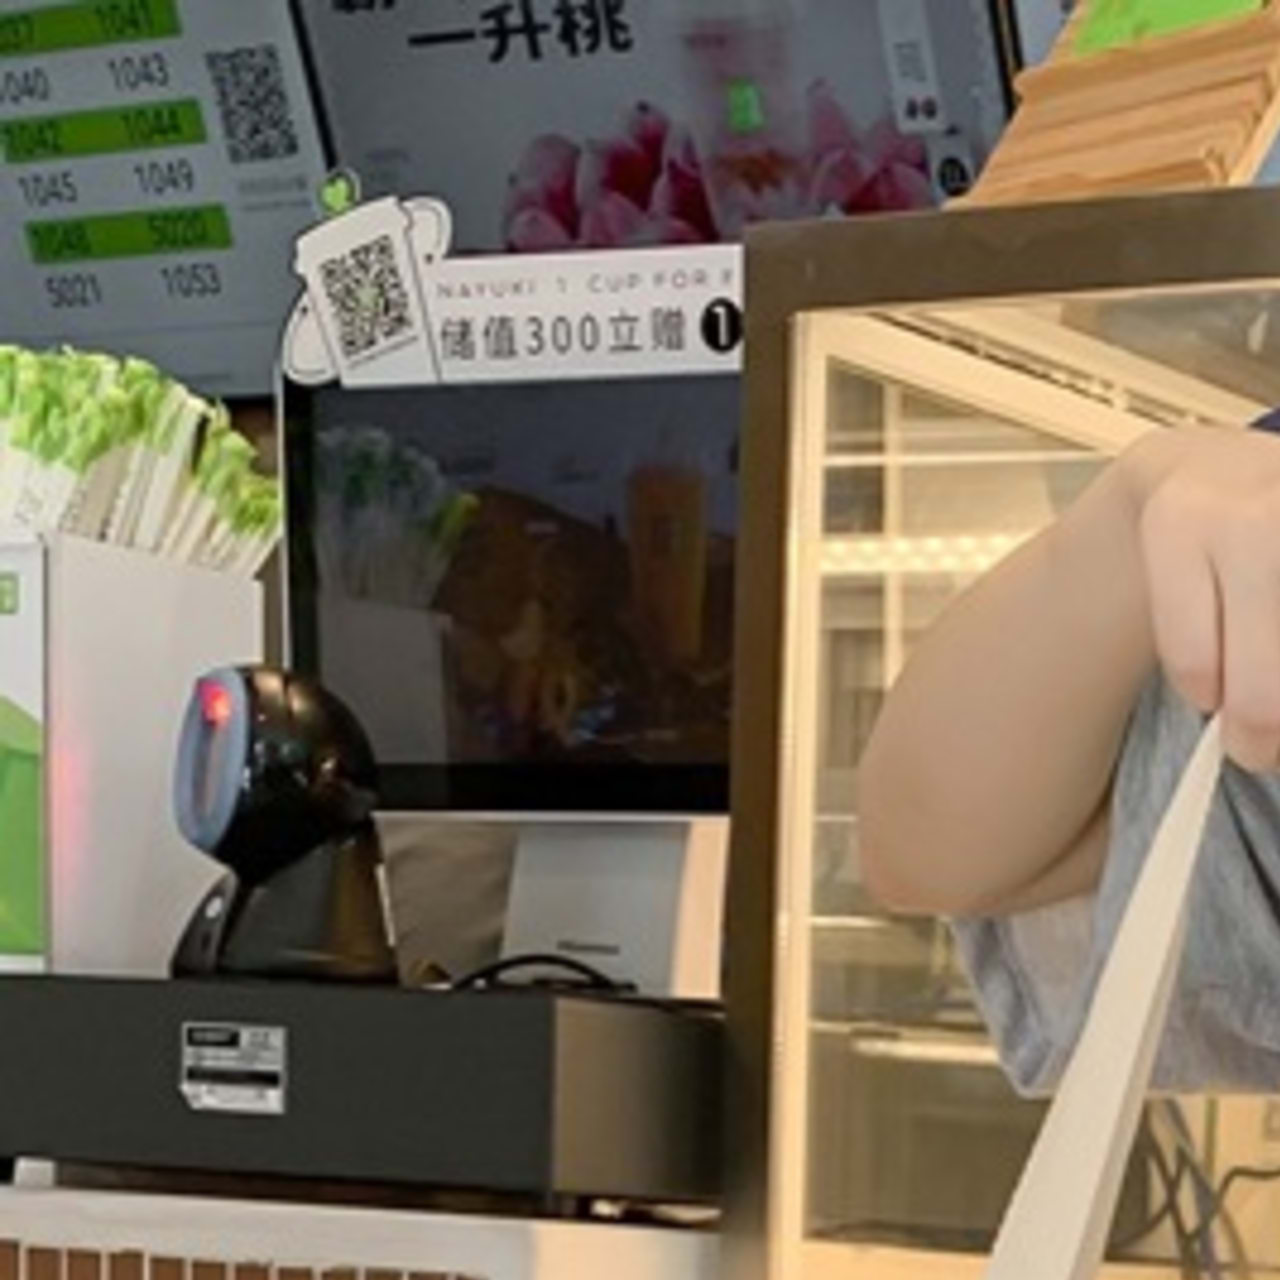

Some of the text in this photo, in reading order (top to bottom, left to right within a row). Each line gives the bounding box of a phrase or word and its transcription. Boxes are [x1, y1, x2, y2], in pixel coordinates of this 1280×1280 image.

[408, 0, 635, 62] 一升桃
[0, 51, 170, 104] 040 1043
[120, 107, 182, 144] 1044
[18, 158, 194, 206] 1045 1049
[160, 262, 222, 297] 1053
[588, 271, 642, 294] CUP
[652, 268, 709, 289] FOR
